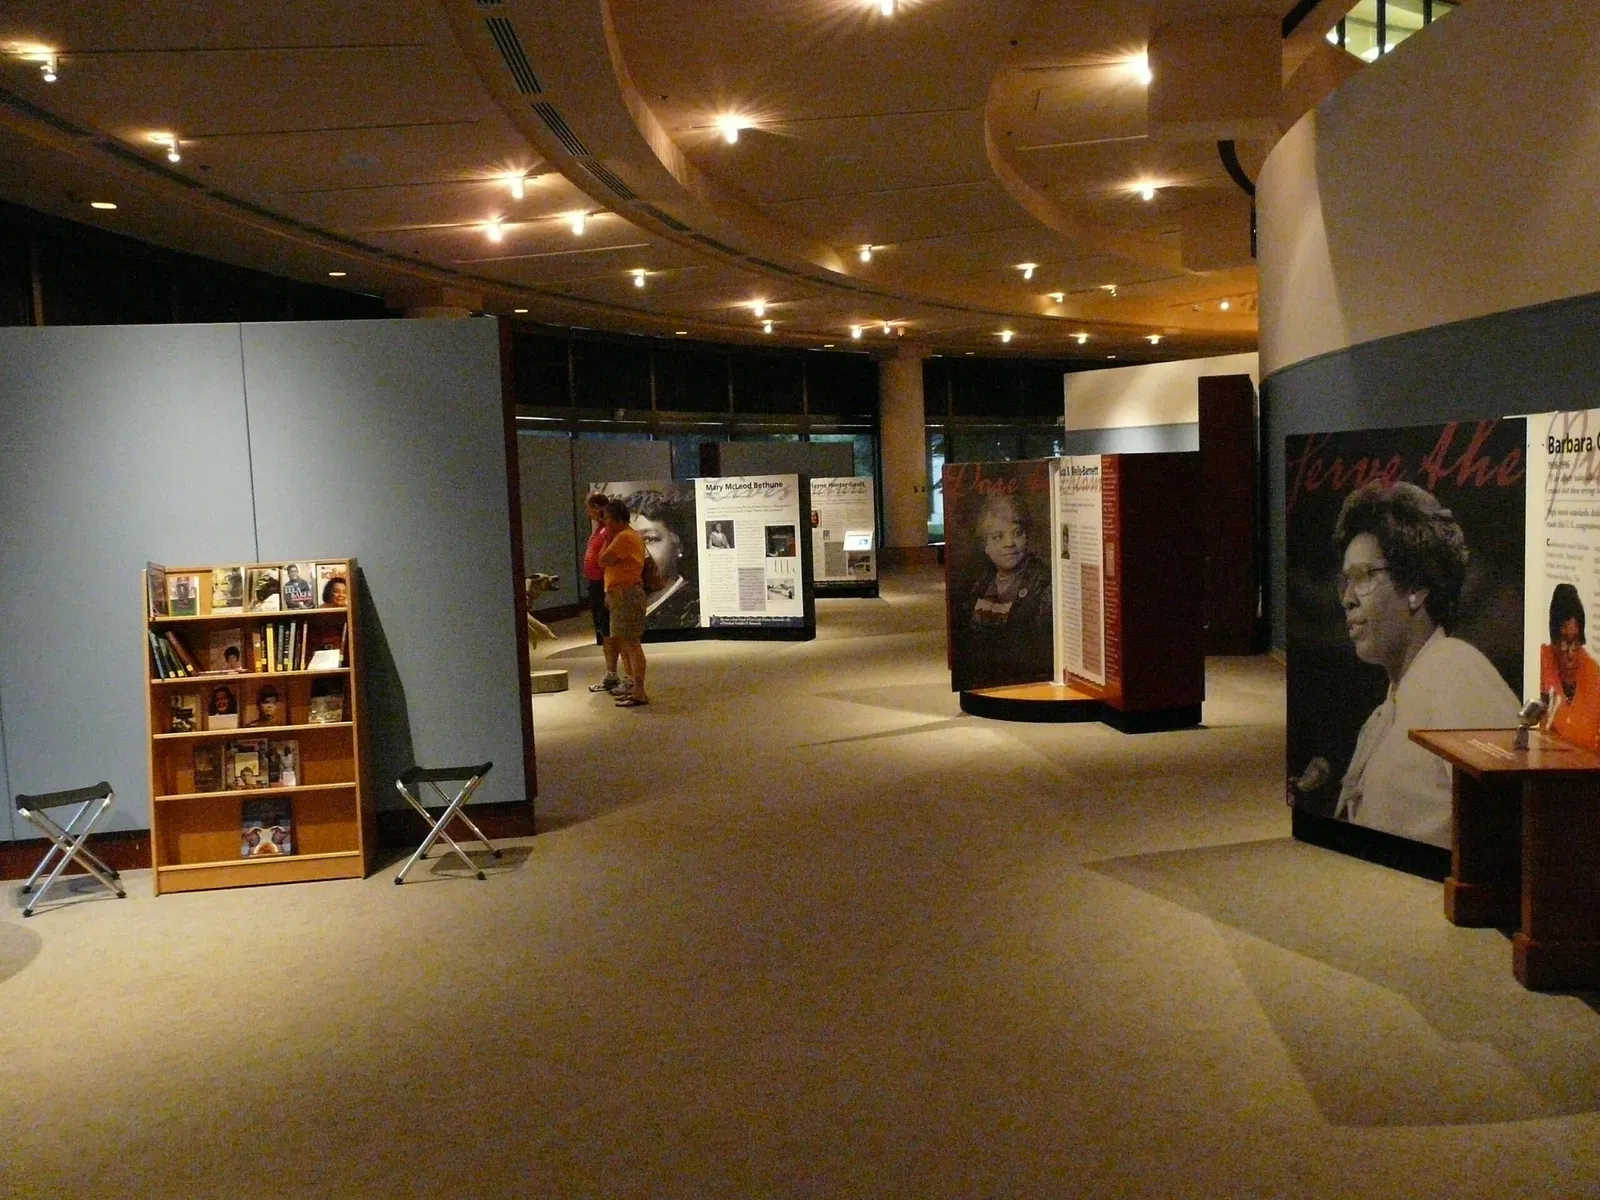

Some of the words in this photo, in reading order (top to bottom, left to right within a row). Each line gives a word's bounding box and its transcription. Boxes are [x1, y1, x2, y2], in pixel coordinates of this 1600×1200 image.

[1548, 432, 1593, 454] Barbara
[1420, 419, 1526, 491] the
[705, 484, 724, 492] Mary
[725, 482, 752, 490] McLeod
[753, 481, 784, 489] Bethune
